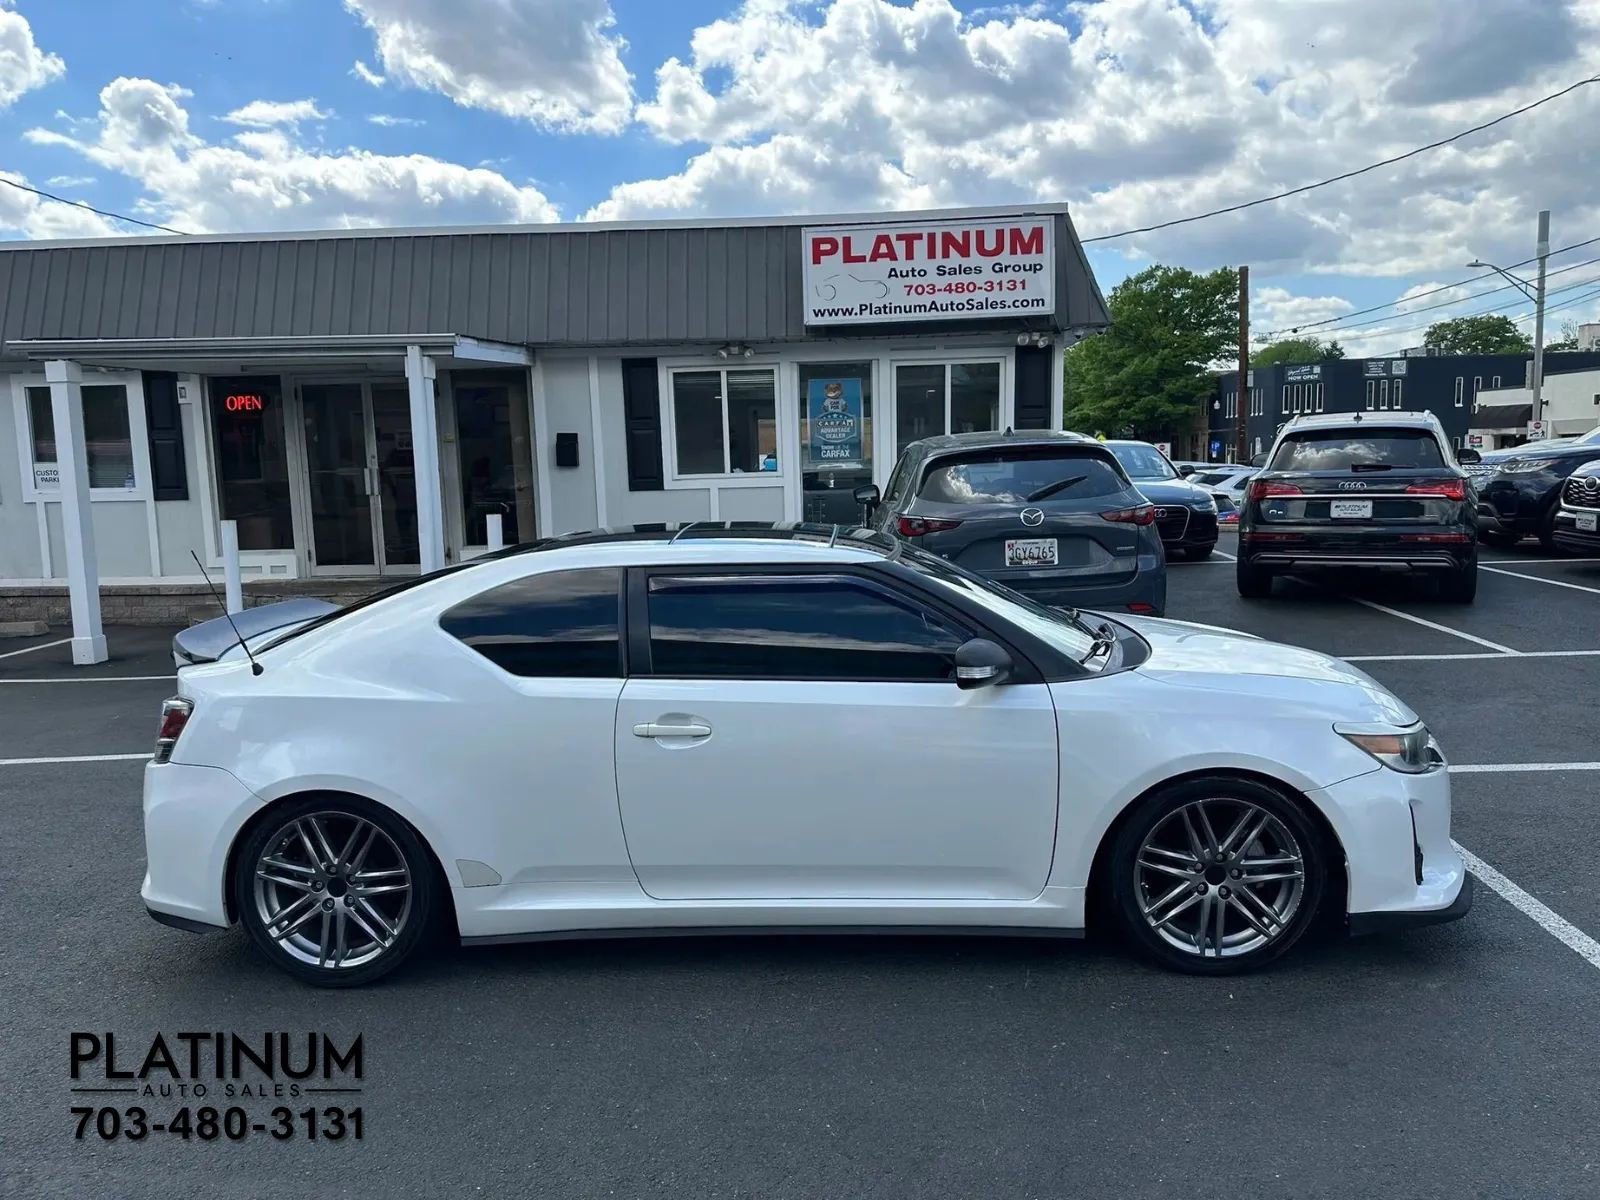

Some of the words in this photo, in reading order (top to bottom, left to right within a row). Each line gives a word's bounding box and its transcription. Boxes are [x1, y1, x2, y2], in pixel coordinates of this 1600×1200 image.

[812, 226, 1044, 264] PLATINUM
[887, 267, 928, 279] Auto
[936, 264, 983, 276] Sales
[991, 262, 1043, 273] Group
[903, 279, 1027, 296] 703-480-3131
[812, 297, 1045, 318] www.PlatinumAutoSales.com
[226, 395, 262, 411] OPEN
[821, 449, 850, 458] CARFAX
[36, 469, 59, 477] CUSTO
[1008, 546, 1055, 561] 3GY6765
